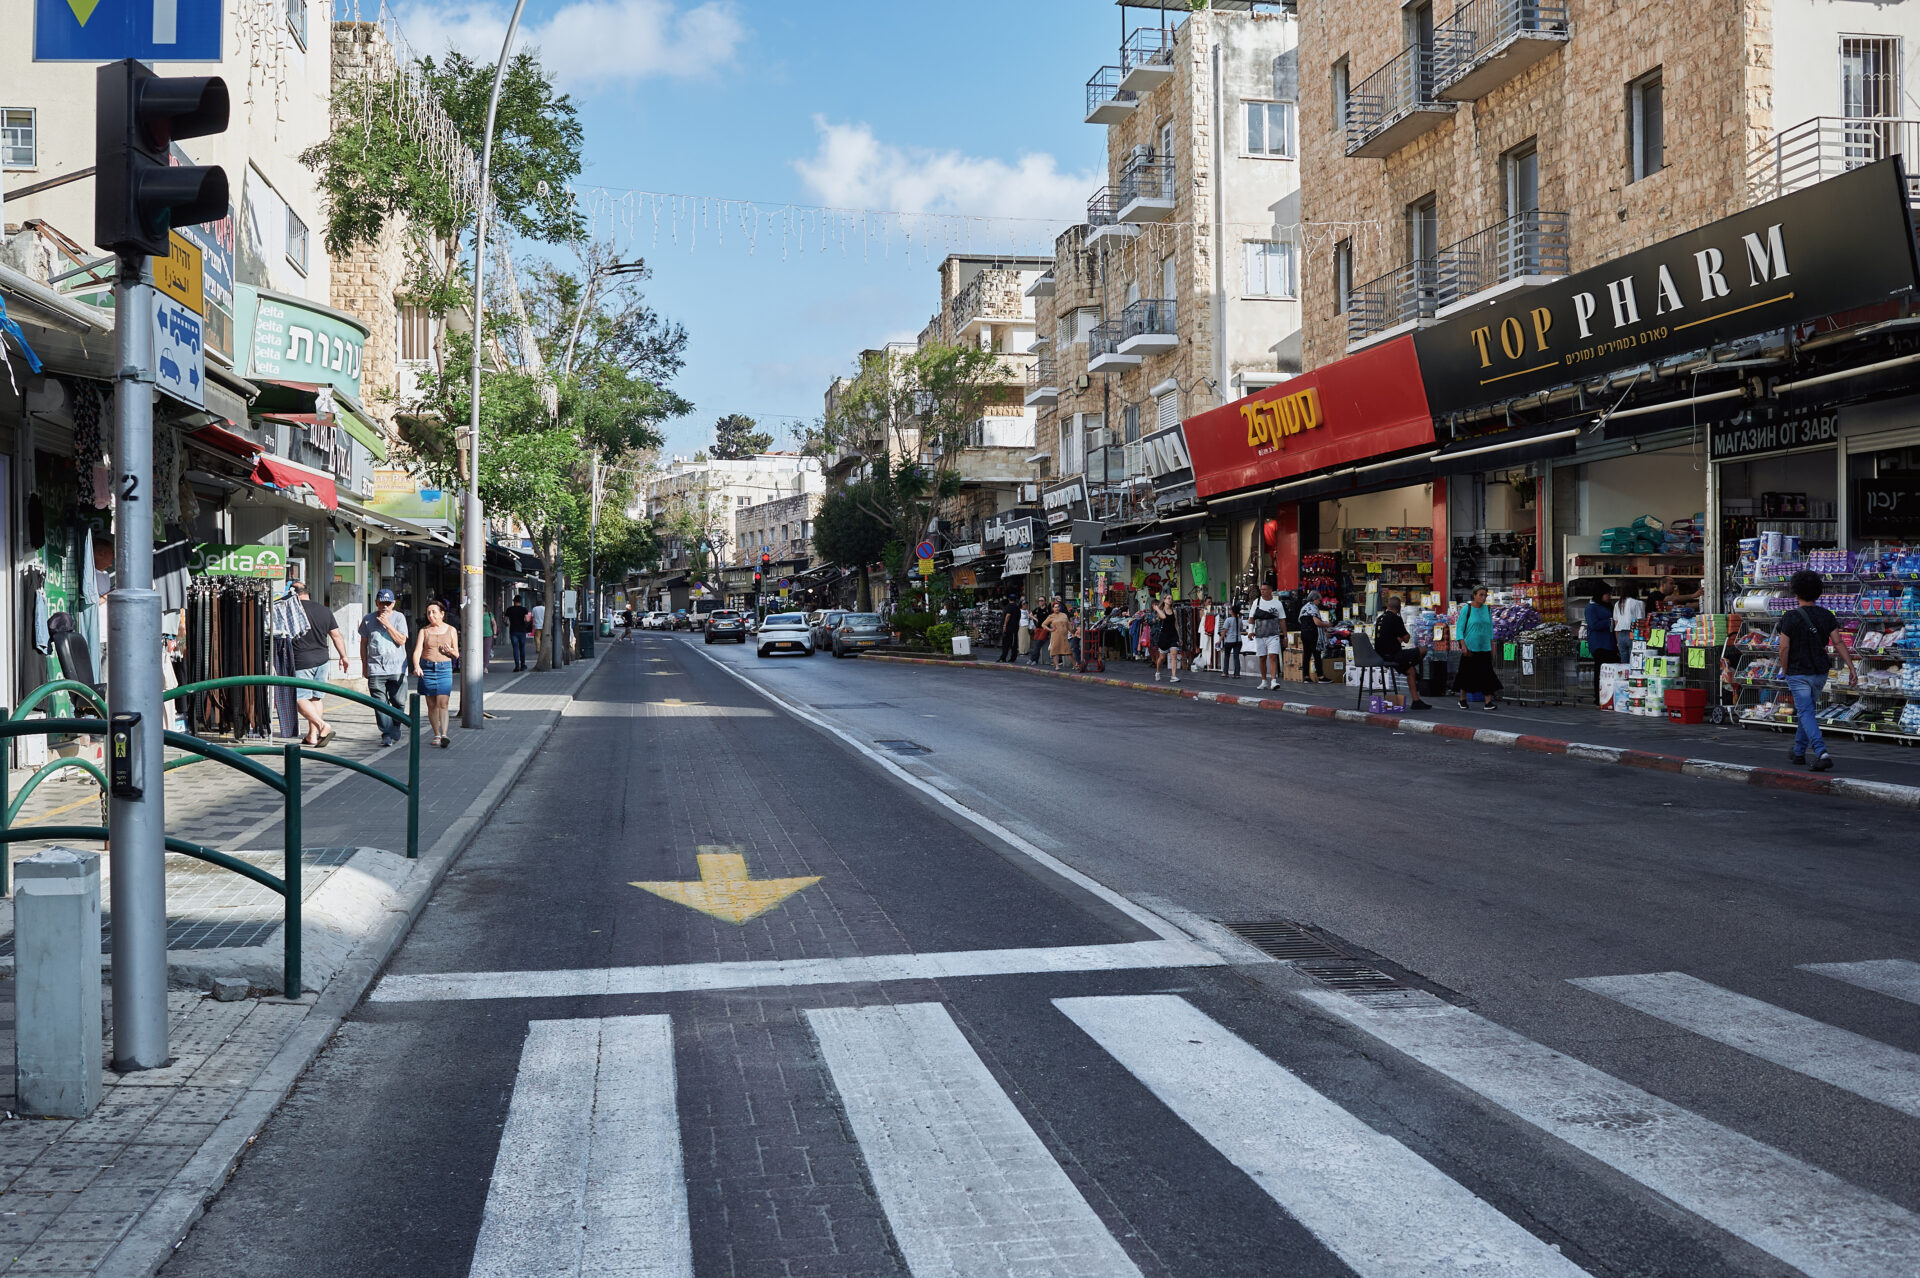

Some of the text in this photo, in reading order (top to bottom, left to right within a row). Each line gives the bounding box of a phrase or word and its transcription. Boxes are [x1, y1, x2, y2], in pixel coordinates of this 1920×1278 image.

[169, 241, 191, 270] זהירו
[1470, 223, 1792, 369] TOP PHARM
[1565, 326, 1669, 365] פארם במחירים נמוכים
[1714, 425, 1777, 456] МАГАЗИН
[1780, 421, 1799, 445] ОТ
[121, 474, 139, 501] 2
[186, 550, 254, 572] Delta
